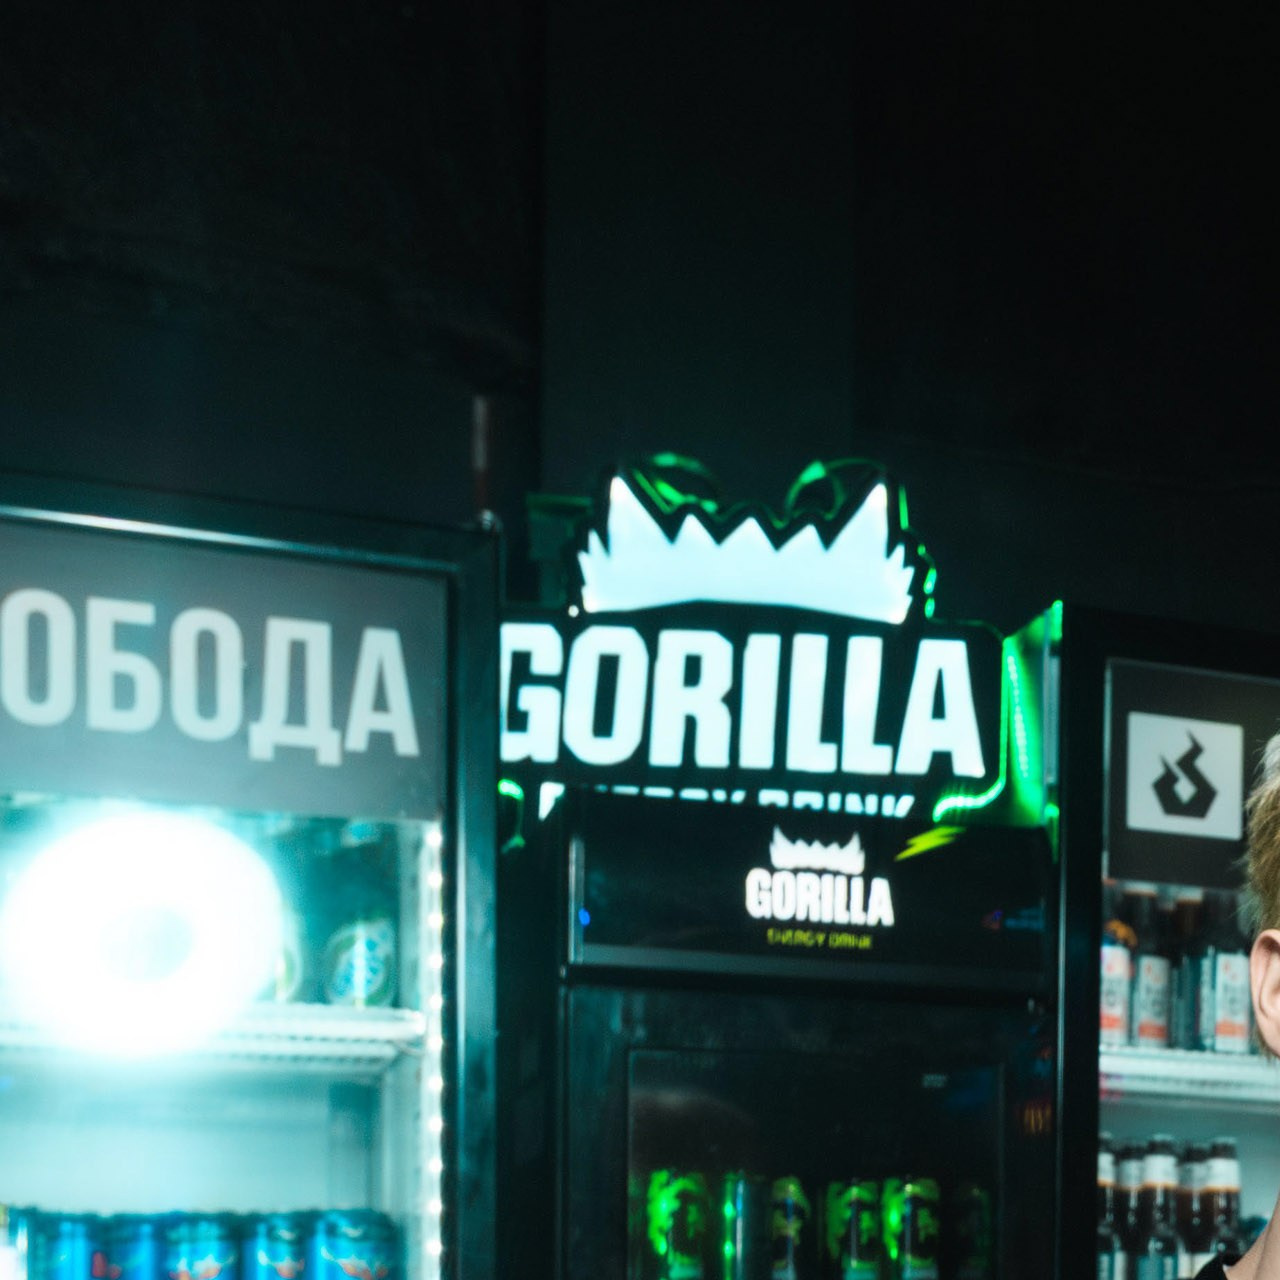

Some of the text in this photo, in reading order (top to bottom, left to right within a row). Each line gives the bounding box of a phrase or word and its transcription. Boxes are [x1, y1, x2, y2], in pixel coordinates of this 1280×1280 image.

[0, 588, 420, 766] ОБОДА
[500, 621, 986, 778] GORILLA
[745, 867, 895, 927] GORILLA
